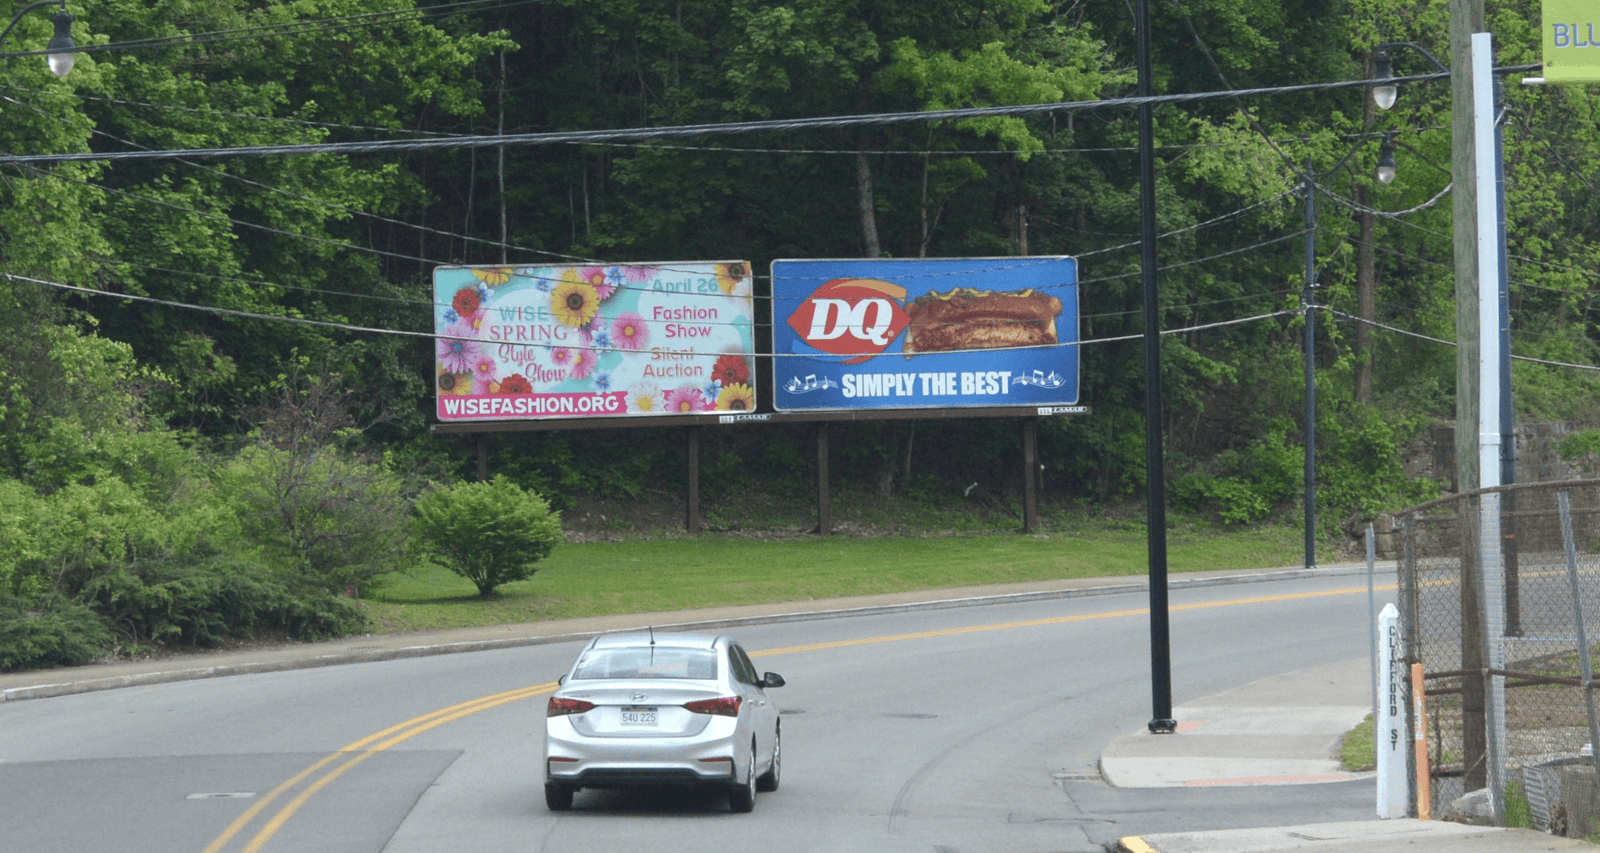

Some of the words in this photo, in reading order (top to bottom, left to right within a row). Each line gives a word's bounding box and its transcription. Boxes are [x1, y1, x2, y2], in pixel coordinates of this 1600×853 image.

[652, 278, 692, 296] April
[697, 277, 719, 292] 26
[500, 306, 548, 321] WISE
[653, 305, 718, 320] Fashion
[806, 298, 893, 346] DQ
[490, 325, 569, 341] SPRING
[665, 323, 712, 338] Show
[498, 343, 535, 367] Style
[650, 346, 694, 361] Silent
[525, 362, 567, 382] Show
[643, 363, 703, 378] Auction
[842, 373, 915, 398] SIMPLY
[916, 372, 958, 396] THE
[960, 371, 1012, 395] BEST
[444, 396, 619, 415] WISEFASHION.ORG
[1389, 625, 1397, 717] CLIFFORD
[622, 712, 638, 722] 54U
[641, 712, 656, 722] 225
[1391, 728, 1397, 751] ST
